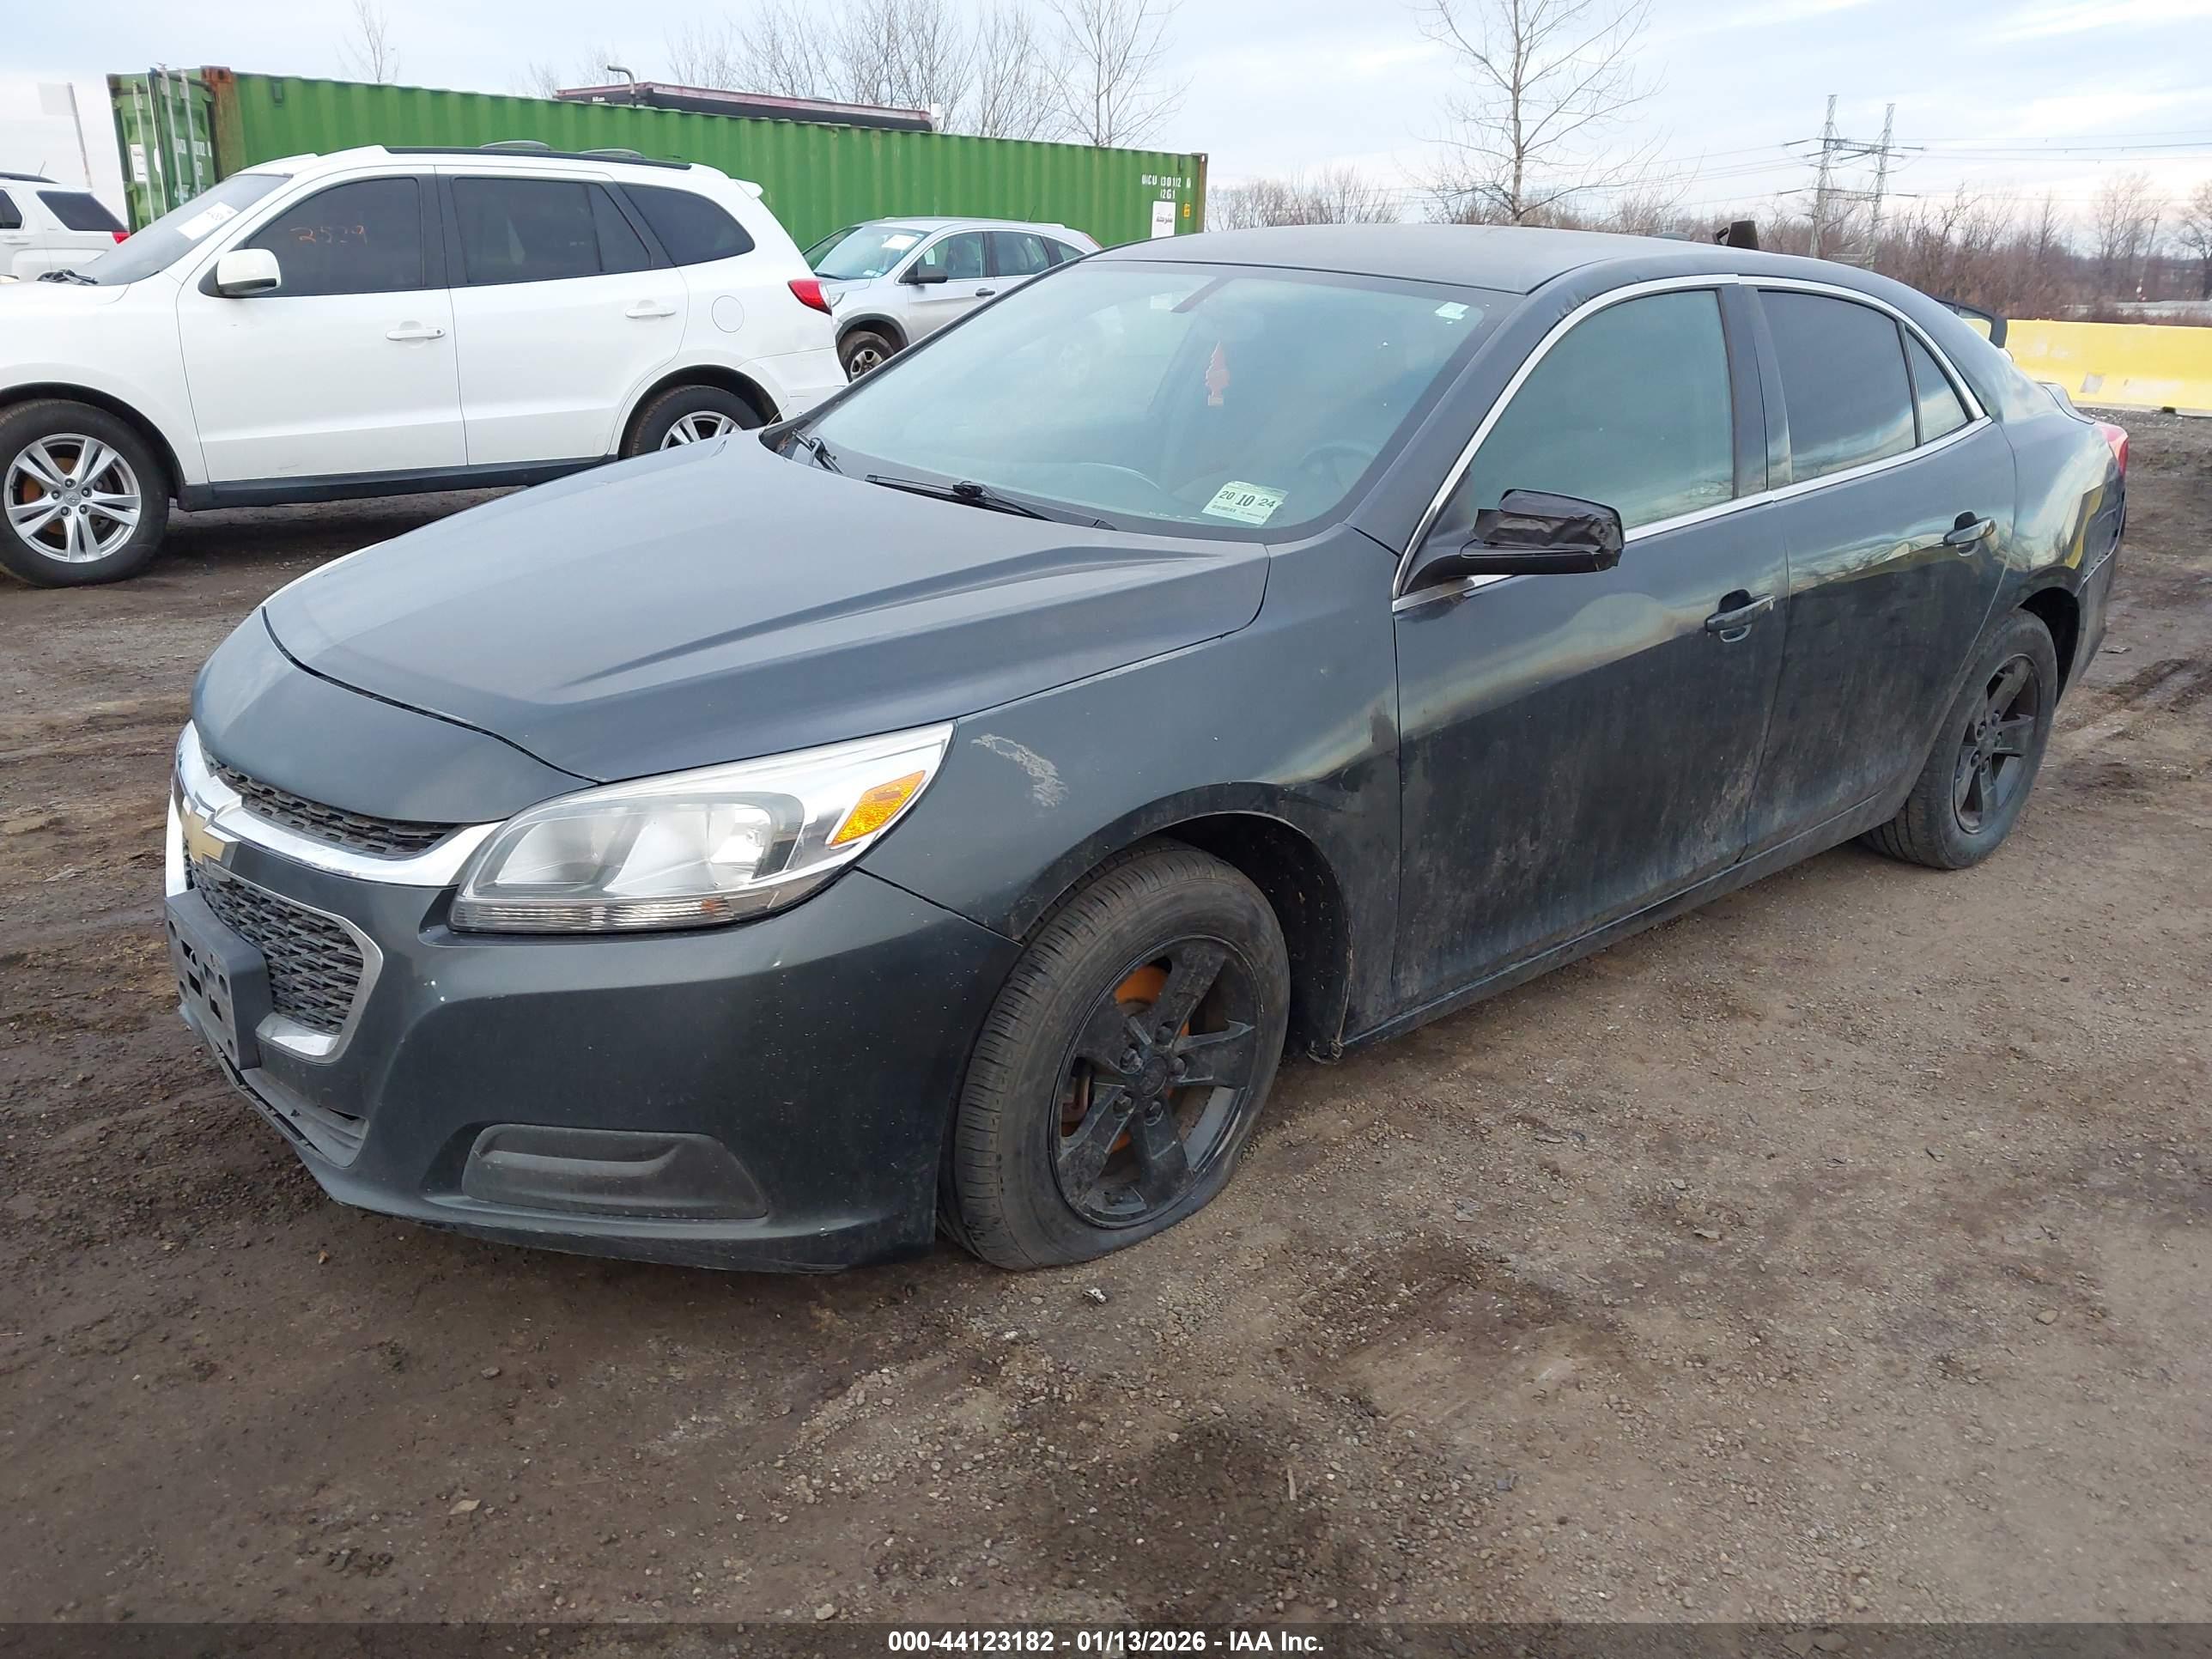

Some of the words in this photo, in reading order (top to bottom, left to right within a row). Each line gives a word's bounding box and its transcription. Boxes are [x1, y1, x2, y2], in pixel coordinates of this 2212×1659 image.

[1219, 490, 1236, 501] 20
[1235, 494, 1255, 507] 10
[1257, 498, 1276, 508] 24
